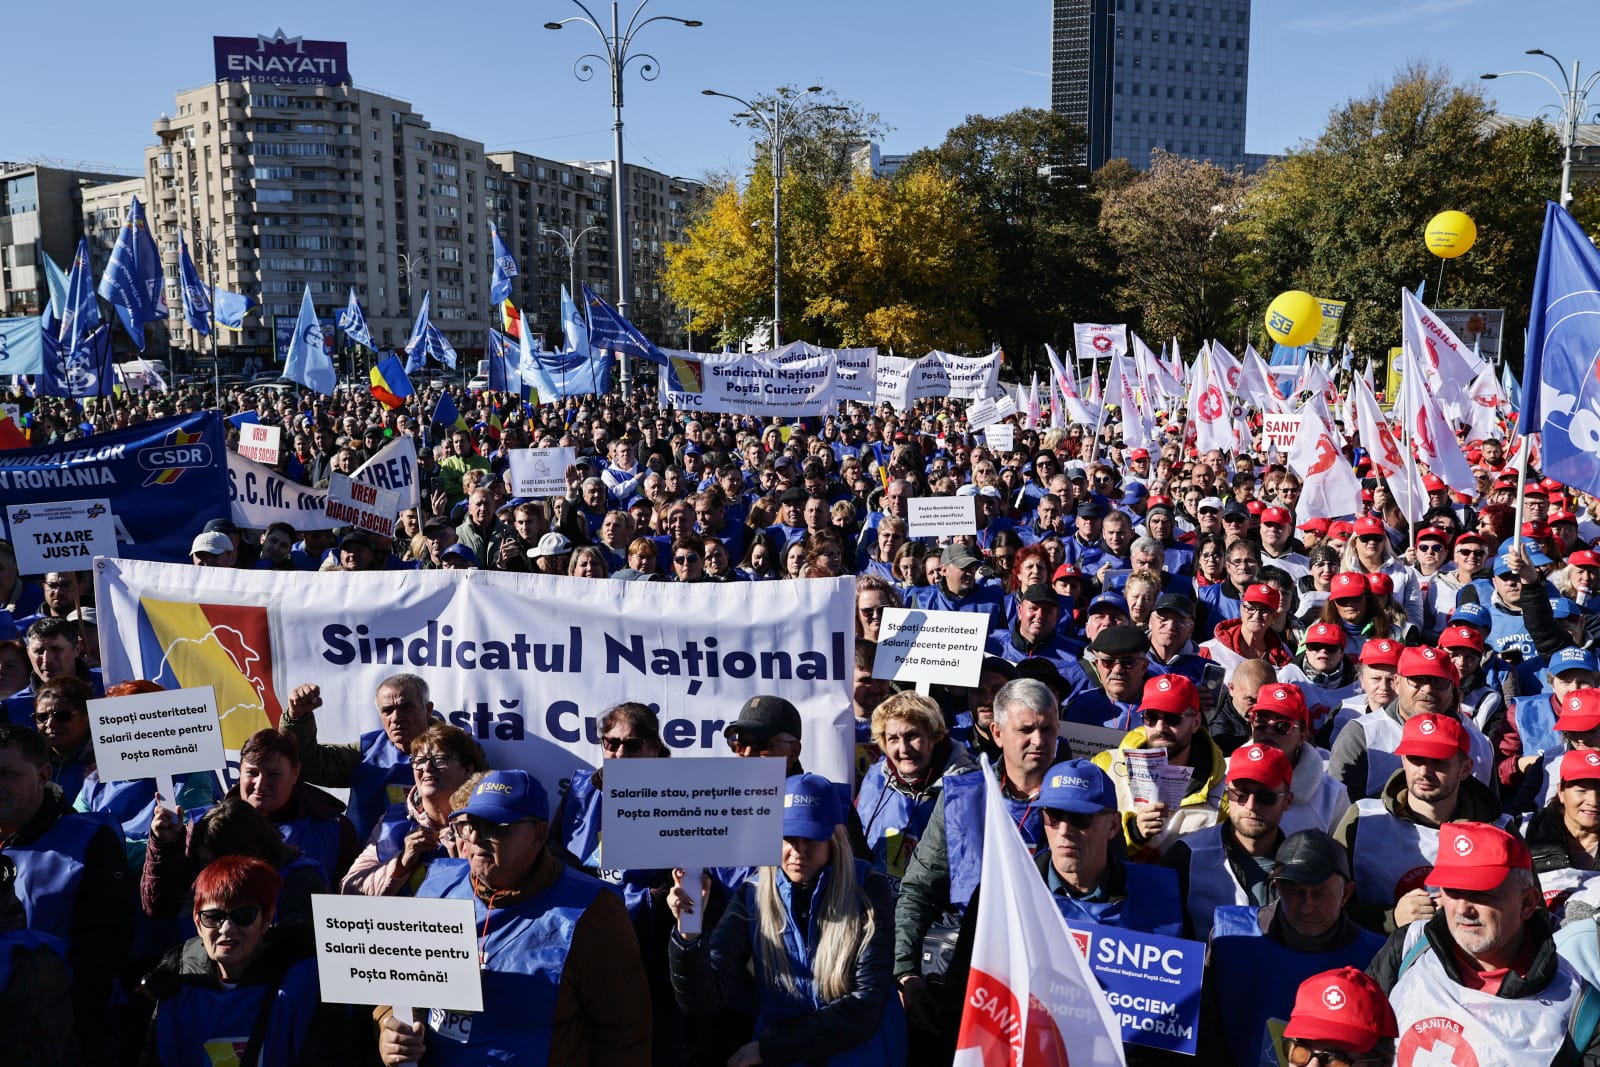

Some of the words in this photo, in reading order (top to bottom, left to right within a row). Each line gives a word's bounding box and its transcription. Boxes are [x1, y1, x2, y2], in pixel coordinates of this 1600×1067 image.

[227, 54, 336, 74] ENAYATI
[712, 365, 774, 378] Sindicatul
[777, 366, 828, 383] Național
[726, 381, 760, 396] Poștă
[764, 384, 815, 395] Curierat
[667, 393, 702, 405] SNPC
[253, 427, 267, 441] VREM
[1266, 421, 1301, 432] SANIT
[1267, 435, 1295, 446] TIM
[149, 449, 203, 465] CSDR
[239, 445, 257, 460] DIALOG
[257, 447, 277, 463] SOCIAL
[12, 465, 116, 489] ROMÂNIA
[352, 483, 377, 506] VREM
[326, 501, 358, 526] DIALOG
[361, 510, 393, 535] SOCIAL
[33, 529, 94, 545] TAXARE
[42, 543, 90, 559] JUSTĂ
[888, 623, 918, 635] Stopați
[920, 625, 978, 635] austeritatea!
[882, 638, 909, 647] Salarii
[911, 640, 946, 650] decente
[948, 642, 978, 652] pentru
[322, 620, 582, 673] Sindicatul
[603, 631, 845, 695] Național
[895, 656, 918, 666] Poșta
[920, 657, 960, 667] Română!
[99, 712, 137, 725] Stopați
[139, 704, 207, 720] austeritatea!
[99, 732, 132, 744] Salarii
[134, 728, 176, 740] decente
[178, 724, 213, 736] pentru
[121, 748, 150, 762] Poșta
[152, 744, 198, 757] Română!
[485, 782, 512, 794] SNPC
[1062, 775, 1089, 788] SNPC
[611, 787, 658, 799] Salariile
[660, 789, 690, 799] stau,
[692, 786, 742, 800] prețurile
[744, 786, 778, 797] cresc!
[794, 794, 821, 805] SNPC
[617, 808, 650, 821] Poșta
[653, 805, 702, 817] Română
[704, 808, 718, 817] nu
[730, 807, 754, 816] test
[756, 806, 771, 816] de
[659, 826, 728, 837] austeritate!
[326, 917, 374, 934] Stopați
[377, 921, 464, 934] austeritatea!
[325, 942, 366, 954] Salarii
[368, 943, 422, 957] decente
[425, 948, 469, 960] pentru
[1097, 937, 1184, 975] SNPC
[350, 967, 386, 983] Poșta
[389, 969, 448, 983] Română!
[1095, 964, 1121, 974] Sindicatul
[1121, 969, 1143, 978] Național
[1143, 973, 1159, 982] Poștă
[1159, 976, 1180, 985] Curierat
[432, 1008, 471, 1034] SNPC
[970, 987, 1022, 1064] SANITA
[1415, 1018, 1460, 1034] SANITAS
